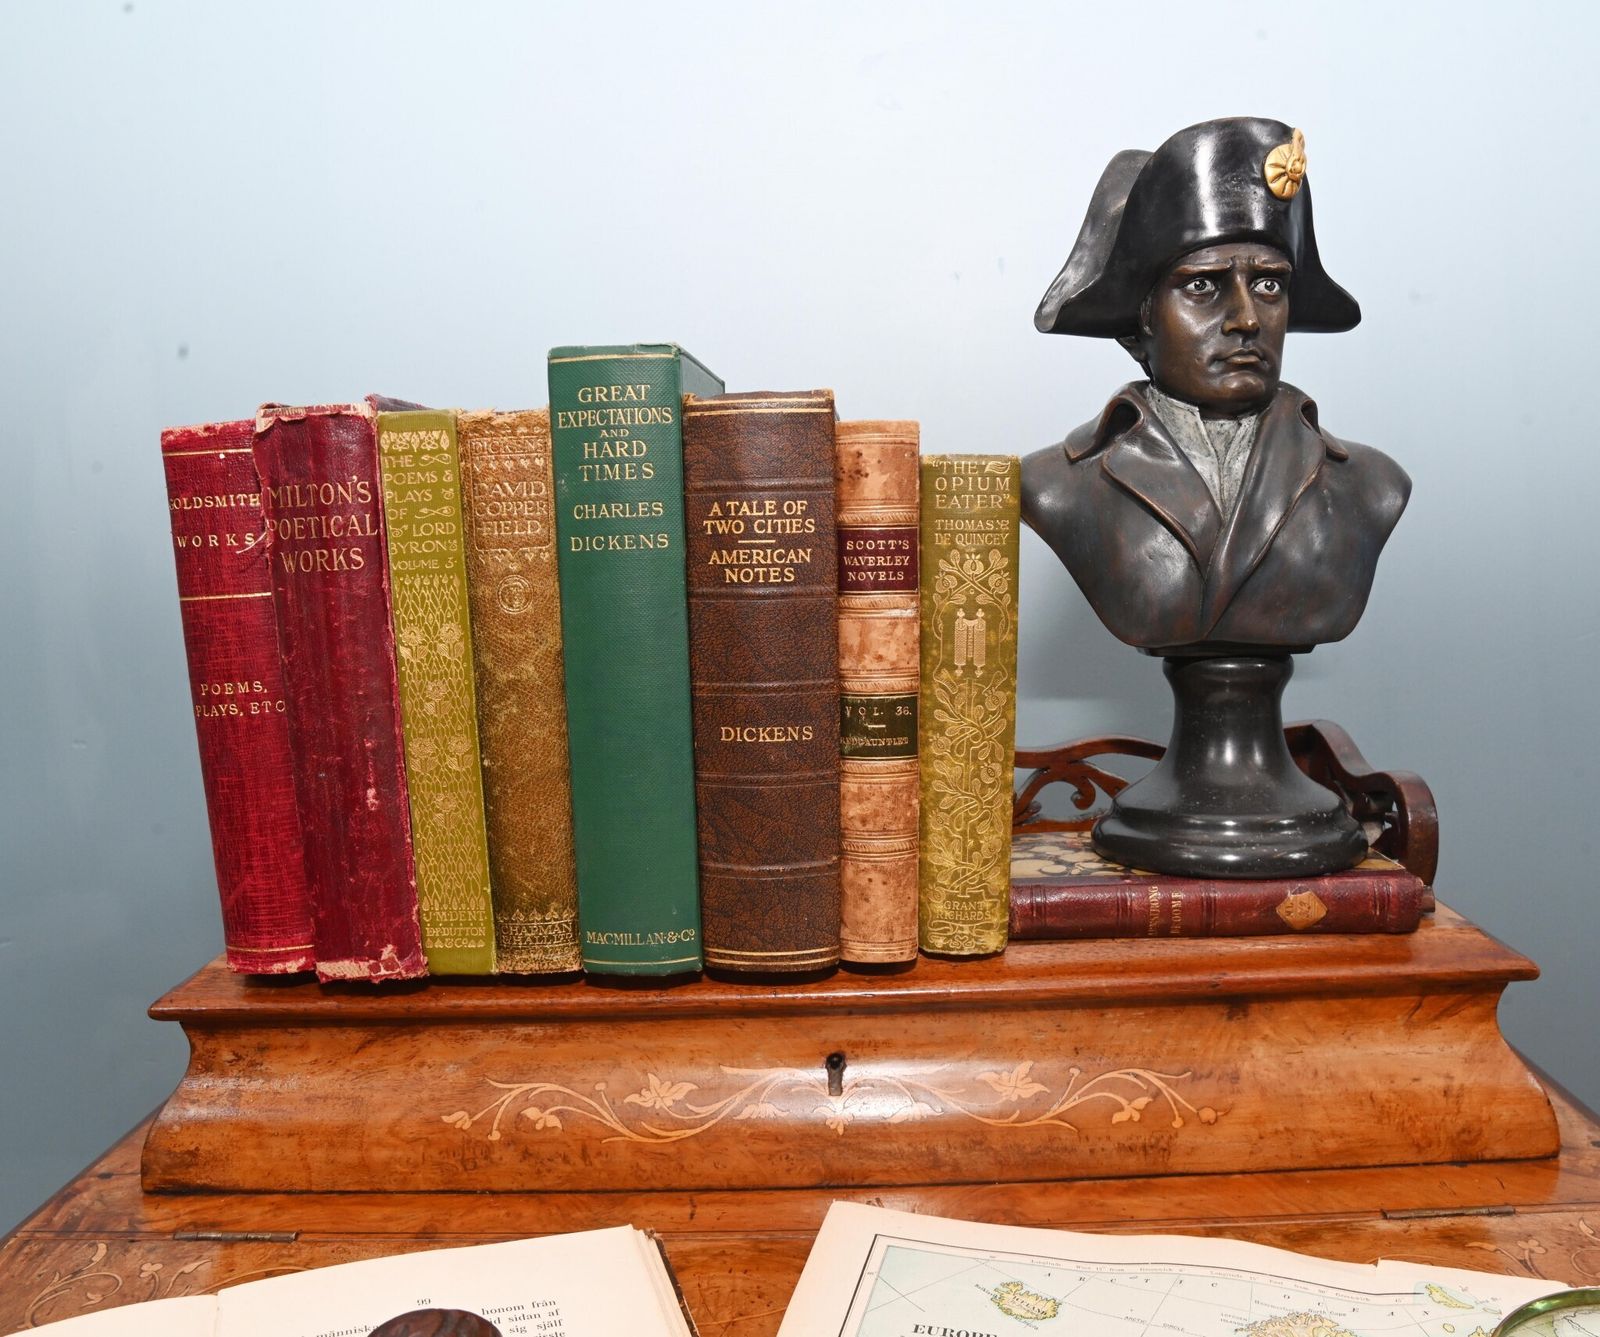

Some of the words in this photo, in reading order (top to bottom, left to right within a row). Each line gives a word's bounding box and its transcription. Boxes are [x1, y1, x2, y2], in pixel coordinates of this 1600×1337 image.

[578, 384, 650, 403] GREAT
[558, 407, 673, 429] EXPECTATIONS
[600, 428, 630, 438] AND
[471, 438, 544, 454] DICKENS
[583, 440, 647, 459] HARD
[384, 455, 415, 469] THE
[384, 471, 438, 486] POEMS
[578, 462, 655, 482] TIMES
[267, 475, 373, 509] MILTON'S
[474, 480, 546, 497] DAVID
[935, 476, 1011, 492] OPIUM
[385, 489, 433, 504] PLAYS
[388, 508, 408, 521] OF
[475, 500, 548, 517] COPPER
[573, 501, 664, 520] CHARLES
[708, 501, 723, 516] A
[726, 500, 777, 516] TALE
[783, 500, 808, 515] OF
[268, 515, 379, 541] POETICAL
[412, 522, 456, 537] LORD
[703, 519, 745, 535] TWO
[753, 518, 816, 534] CITIES
[177, 533, 255, 548] WORKS
[570, 533, 669, 552] DICKENS
[846, 540, 910, 551] SCOTT'S
[935, 533, 951, 545] DE
[955, 532, 1010, 547] QUINCEY
[390, 540, 448, 556] BYRON
[280, 548, 365, 574] WORKS
[708, 548, 812, 565] AMERICAN
[843, 555, 910, 567] WAVERLEY
[392, 559, 440, 571] VOLUME
[724, 567, 795, 583] NOTES
[847, 571, 904, 581] NOVELS
[720, 725, 814, 742] DICKENS
[943, 900, 985, 911] GRANT
[936, 910, 991, 921] RICHARDS
[501, 923, 572, 936] CHAPMAN
[481, 1304, 525, 1316] honom
[531, 1299, 557, 1309] från
[508, 1313, 541, 1323] sidan
[548, 1308, 560, 1318] af
[509, 1325, 528, 1335] sig
